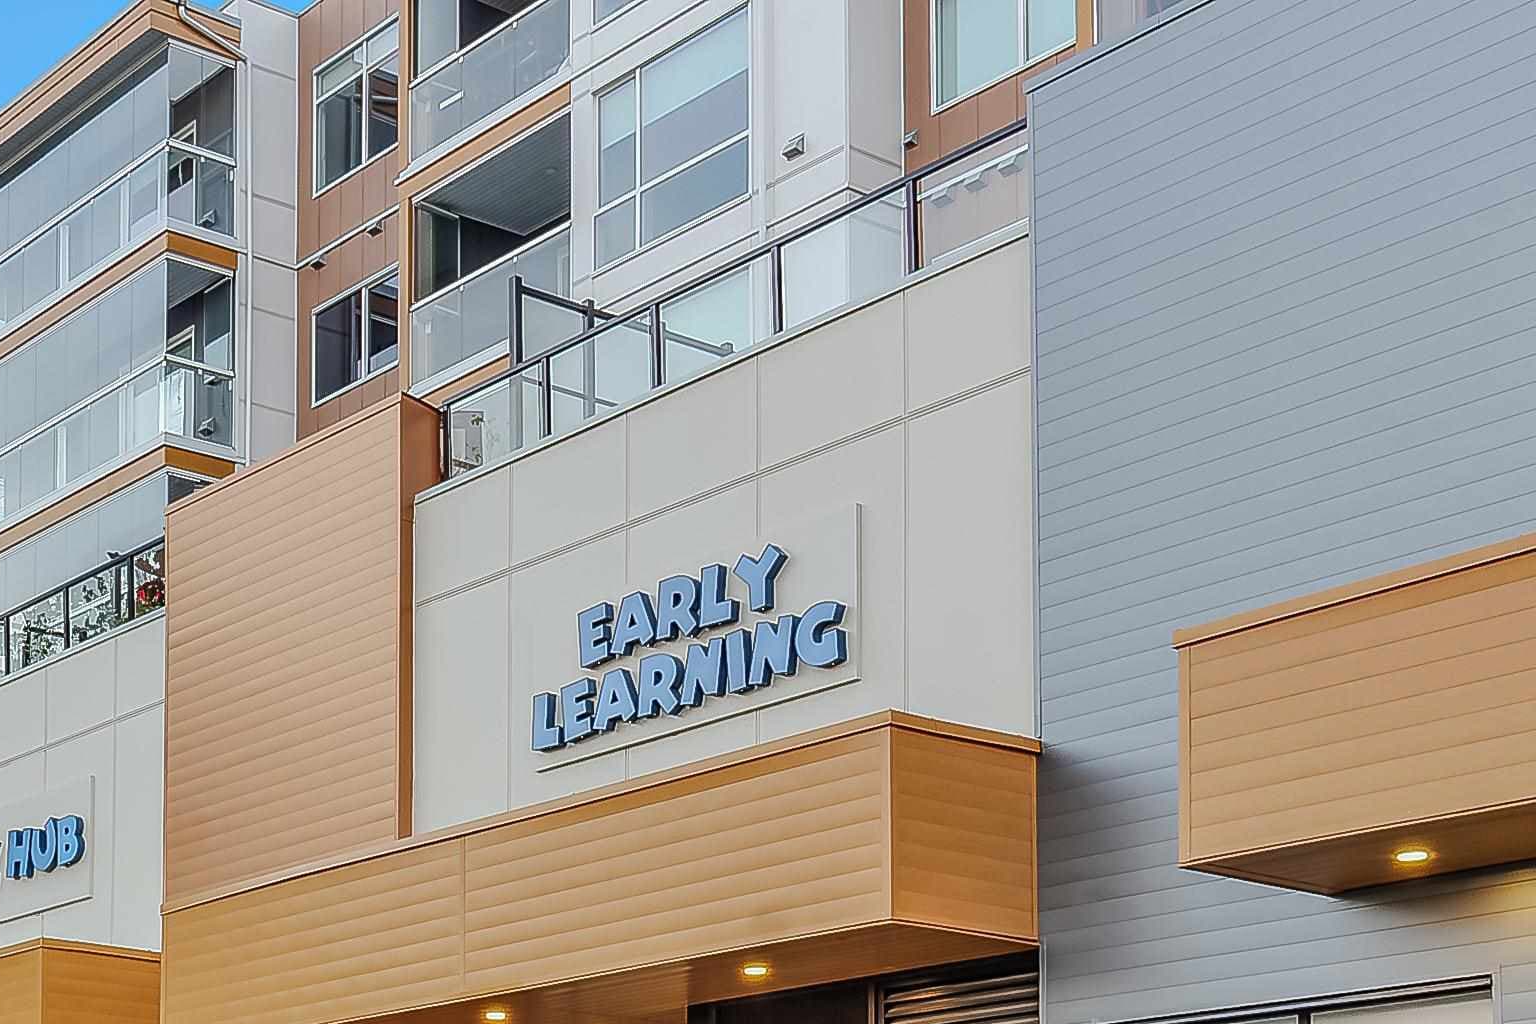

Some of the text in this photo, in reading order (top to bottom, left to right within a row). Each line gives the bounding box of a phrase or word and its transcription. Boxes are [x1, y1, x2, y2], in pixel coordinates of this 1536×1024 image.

[577, 544, 789, 668] EARLY
[531, 601, 848, 751] LEARNING
[6, 815, 85, 879] HUB
